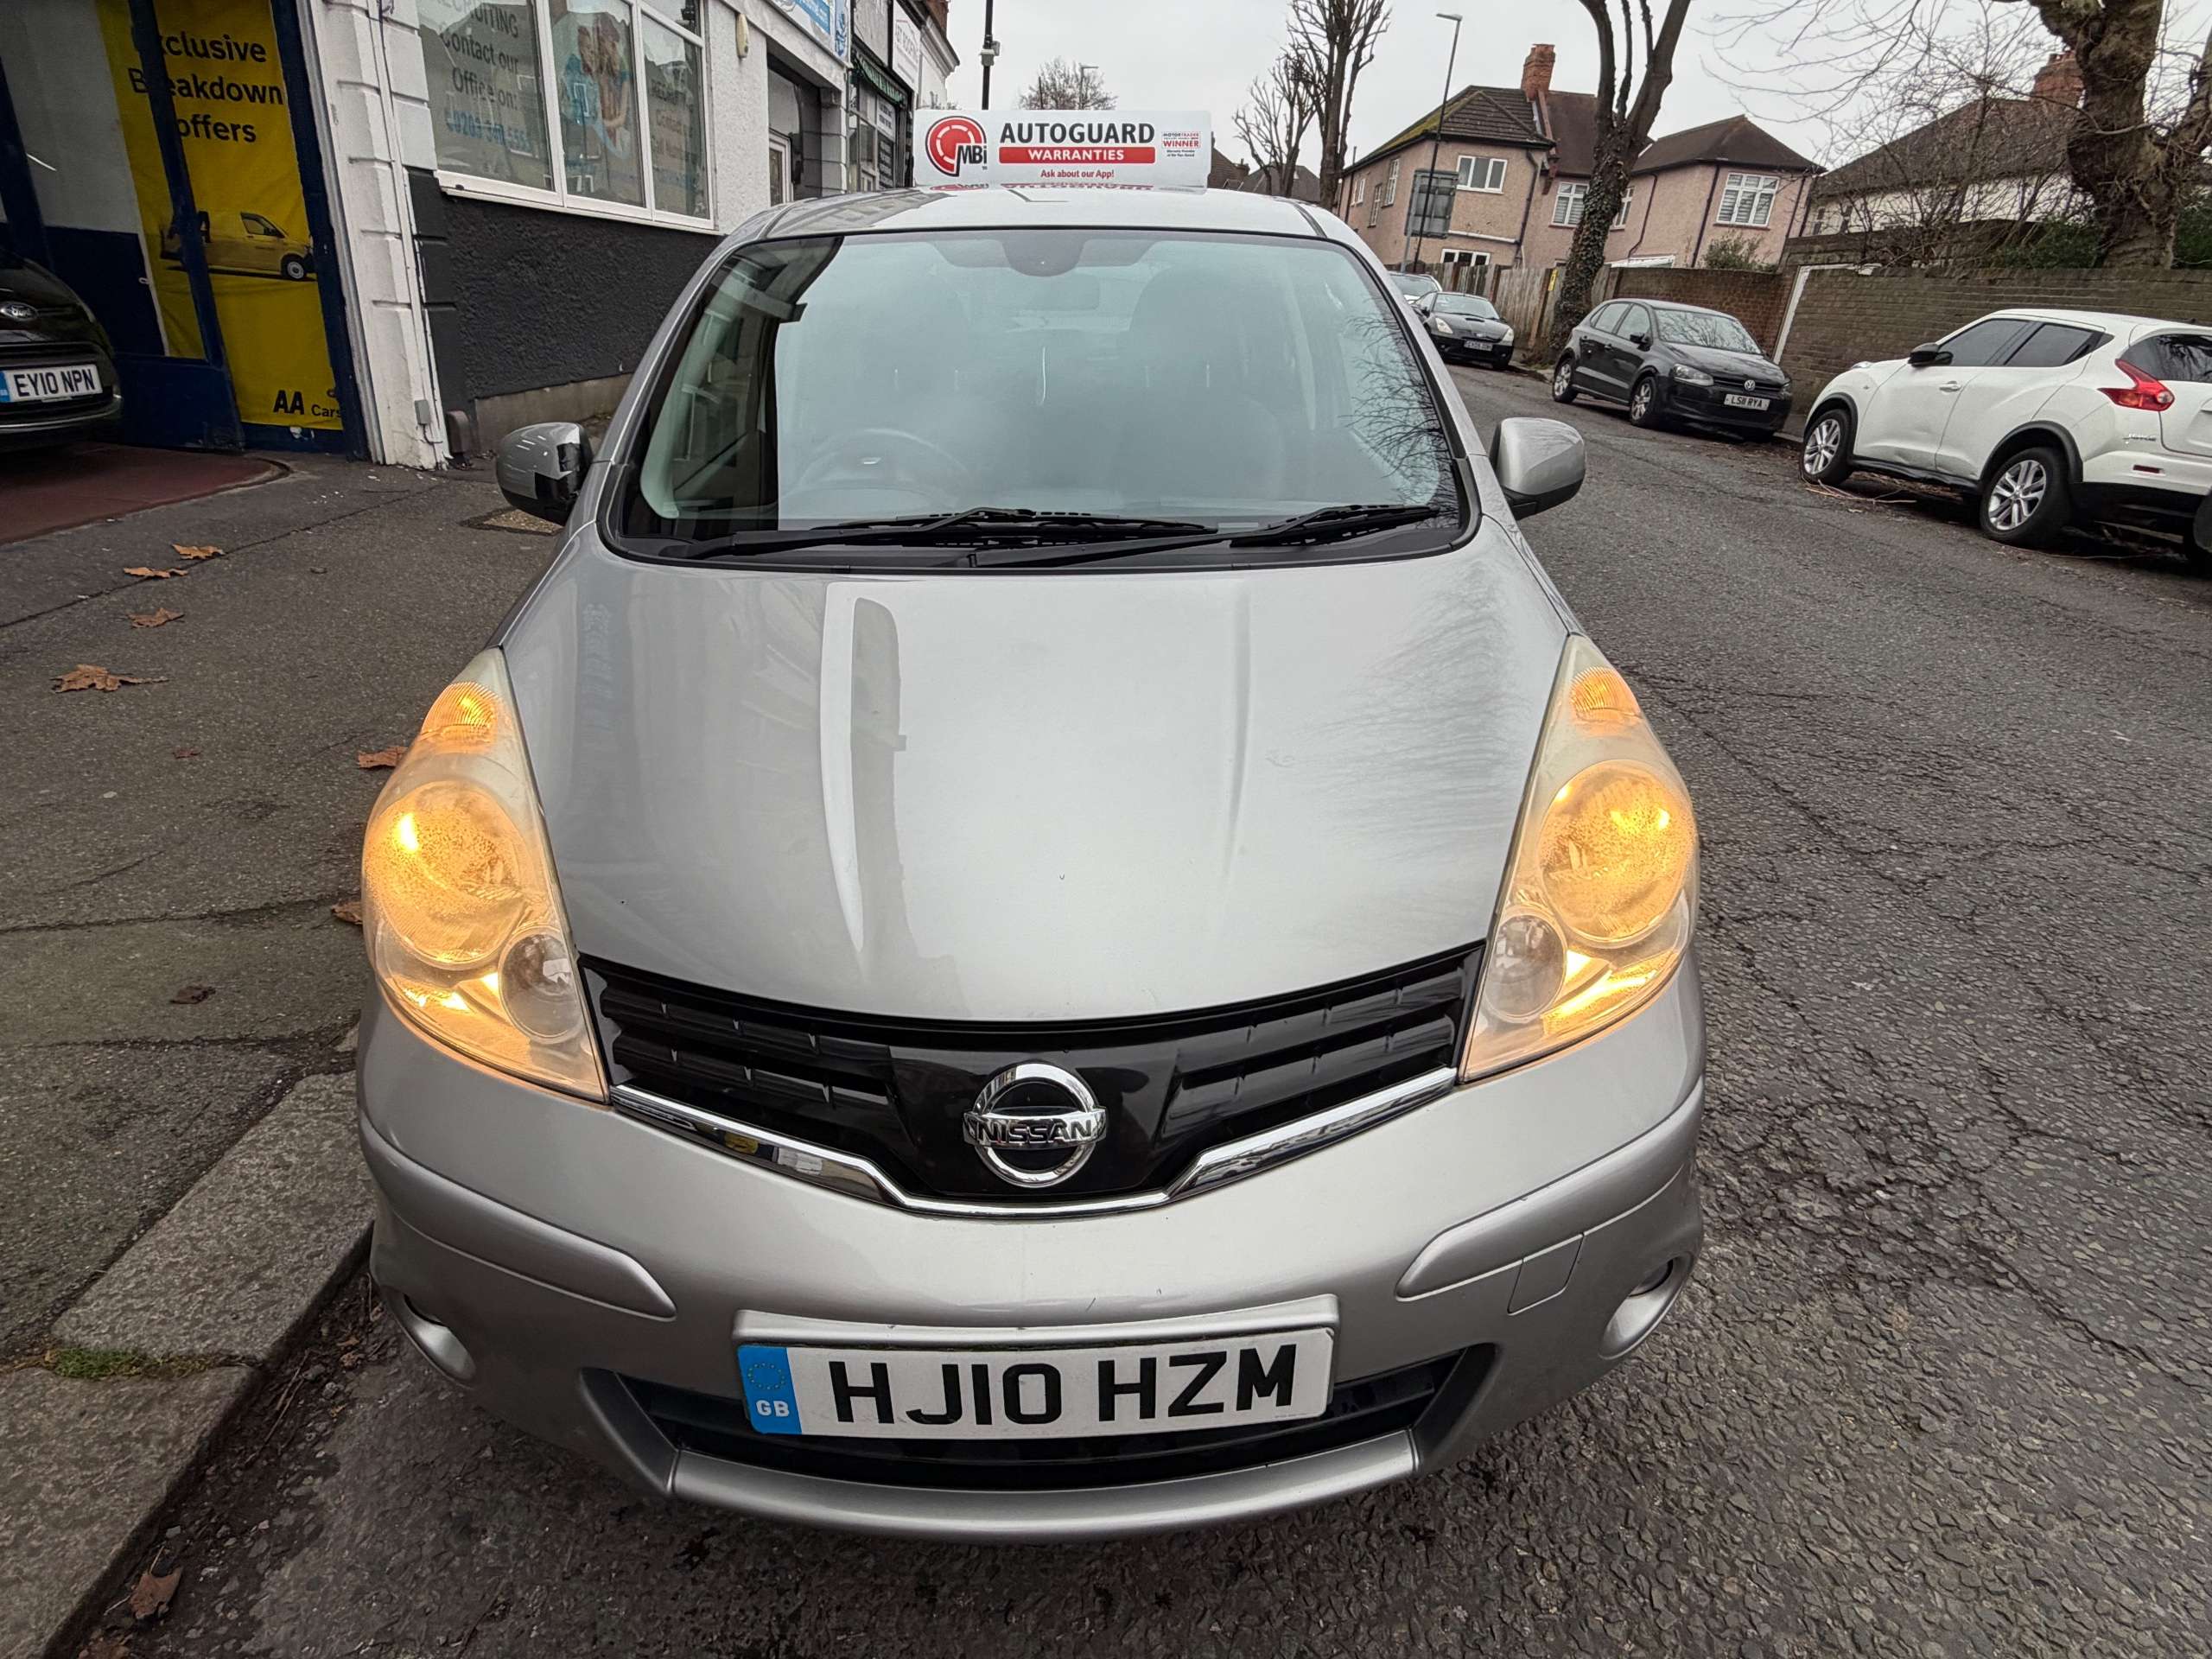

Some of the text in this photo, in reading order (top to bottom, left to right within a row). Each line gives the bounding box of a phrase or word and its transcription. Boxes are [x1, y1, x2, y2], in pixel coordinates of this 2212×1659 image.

[159, 31, 267, 63] clusive
[128, 67, 283, 105] Bakdown
[176, 113, 257, 143] offers
[1000, 123, 1155, 143] AUTOGUARD
[1028, 149, 1124, 161] WARRANTIES
[1040, 169, 1055, 178] Ask
[1057, 169, 1079, 178] about
[1096, 169, 1115, 179] App!
[13, 368, 96, 397] EY10 NPN
[273, 390, 304, 415] AA
[1747, 397, 1763, 407] RYA
[976, 1117, 1092, 1142] NISSAN
[829, 1344, 1296, 1425] HJ10 HZM
[756, 1400, 790, 1417] GB
